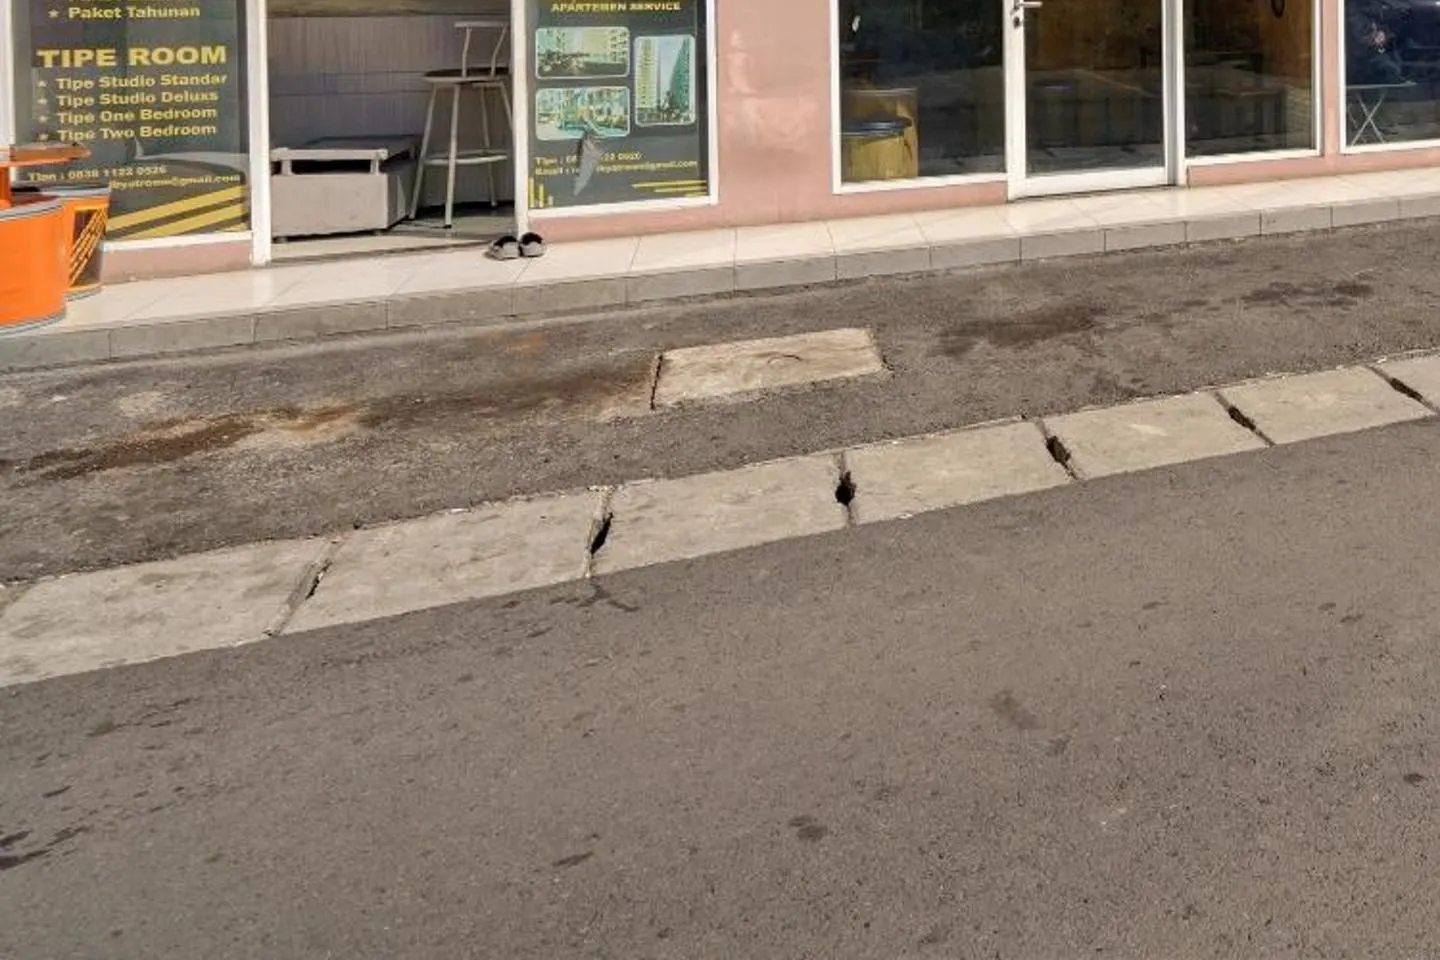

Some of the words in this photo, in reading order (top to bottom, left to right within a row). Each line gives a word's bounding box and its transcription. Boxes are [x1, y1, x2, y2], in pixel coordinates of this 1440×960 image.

[68, 7, 122, 19] Paket
[127, 6, 201, 18] Tahunan
[36, 48, 117, 68] TIPE
[128, 46, 227, 66] ROOM
[56, 77, 94, 91] Tipe
[99, 75, 156, 89] Studio
[160, 73, 227, 86] Standar
[57, 94, 94, 108] Tipe
[99, 93, 156, 106] Studio
[57, 112, 95, 126] Tipe
[99, 110, 135, 122] One
[140, 108, 218, 121] Bedroom
[57, 129, 96, 143] Tipe
[100, 127, 135, 140] Two
[140, 125, 217, 138] Bedroom
